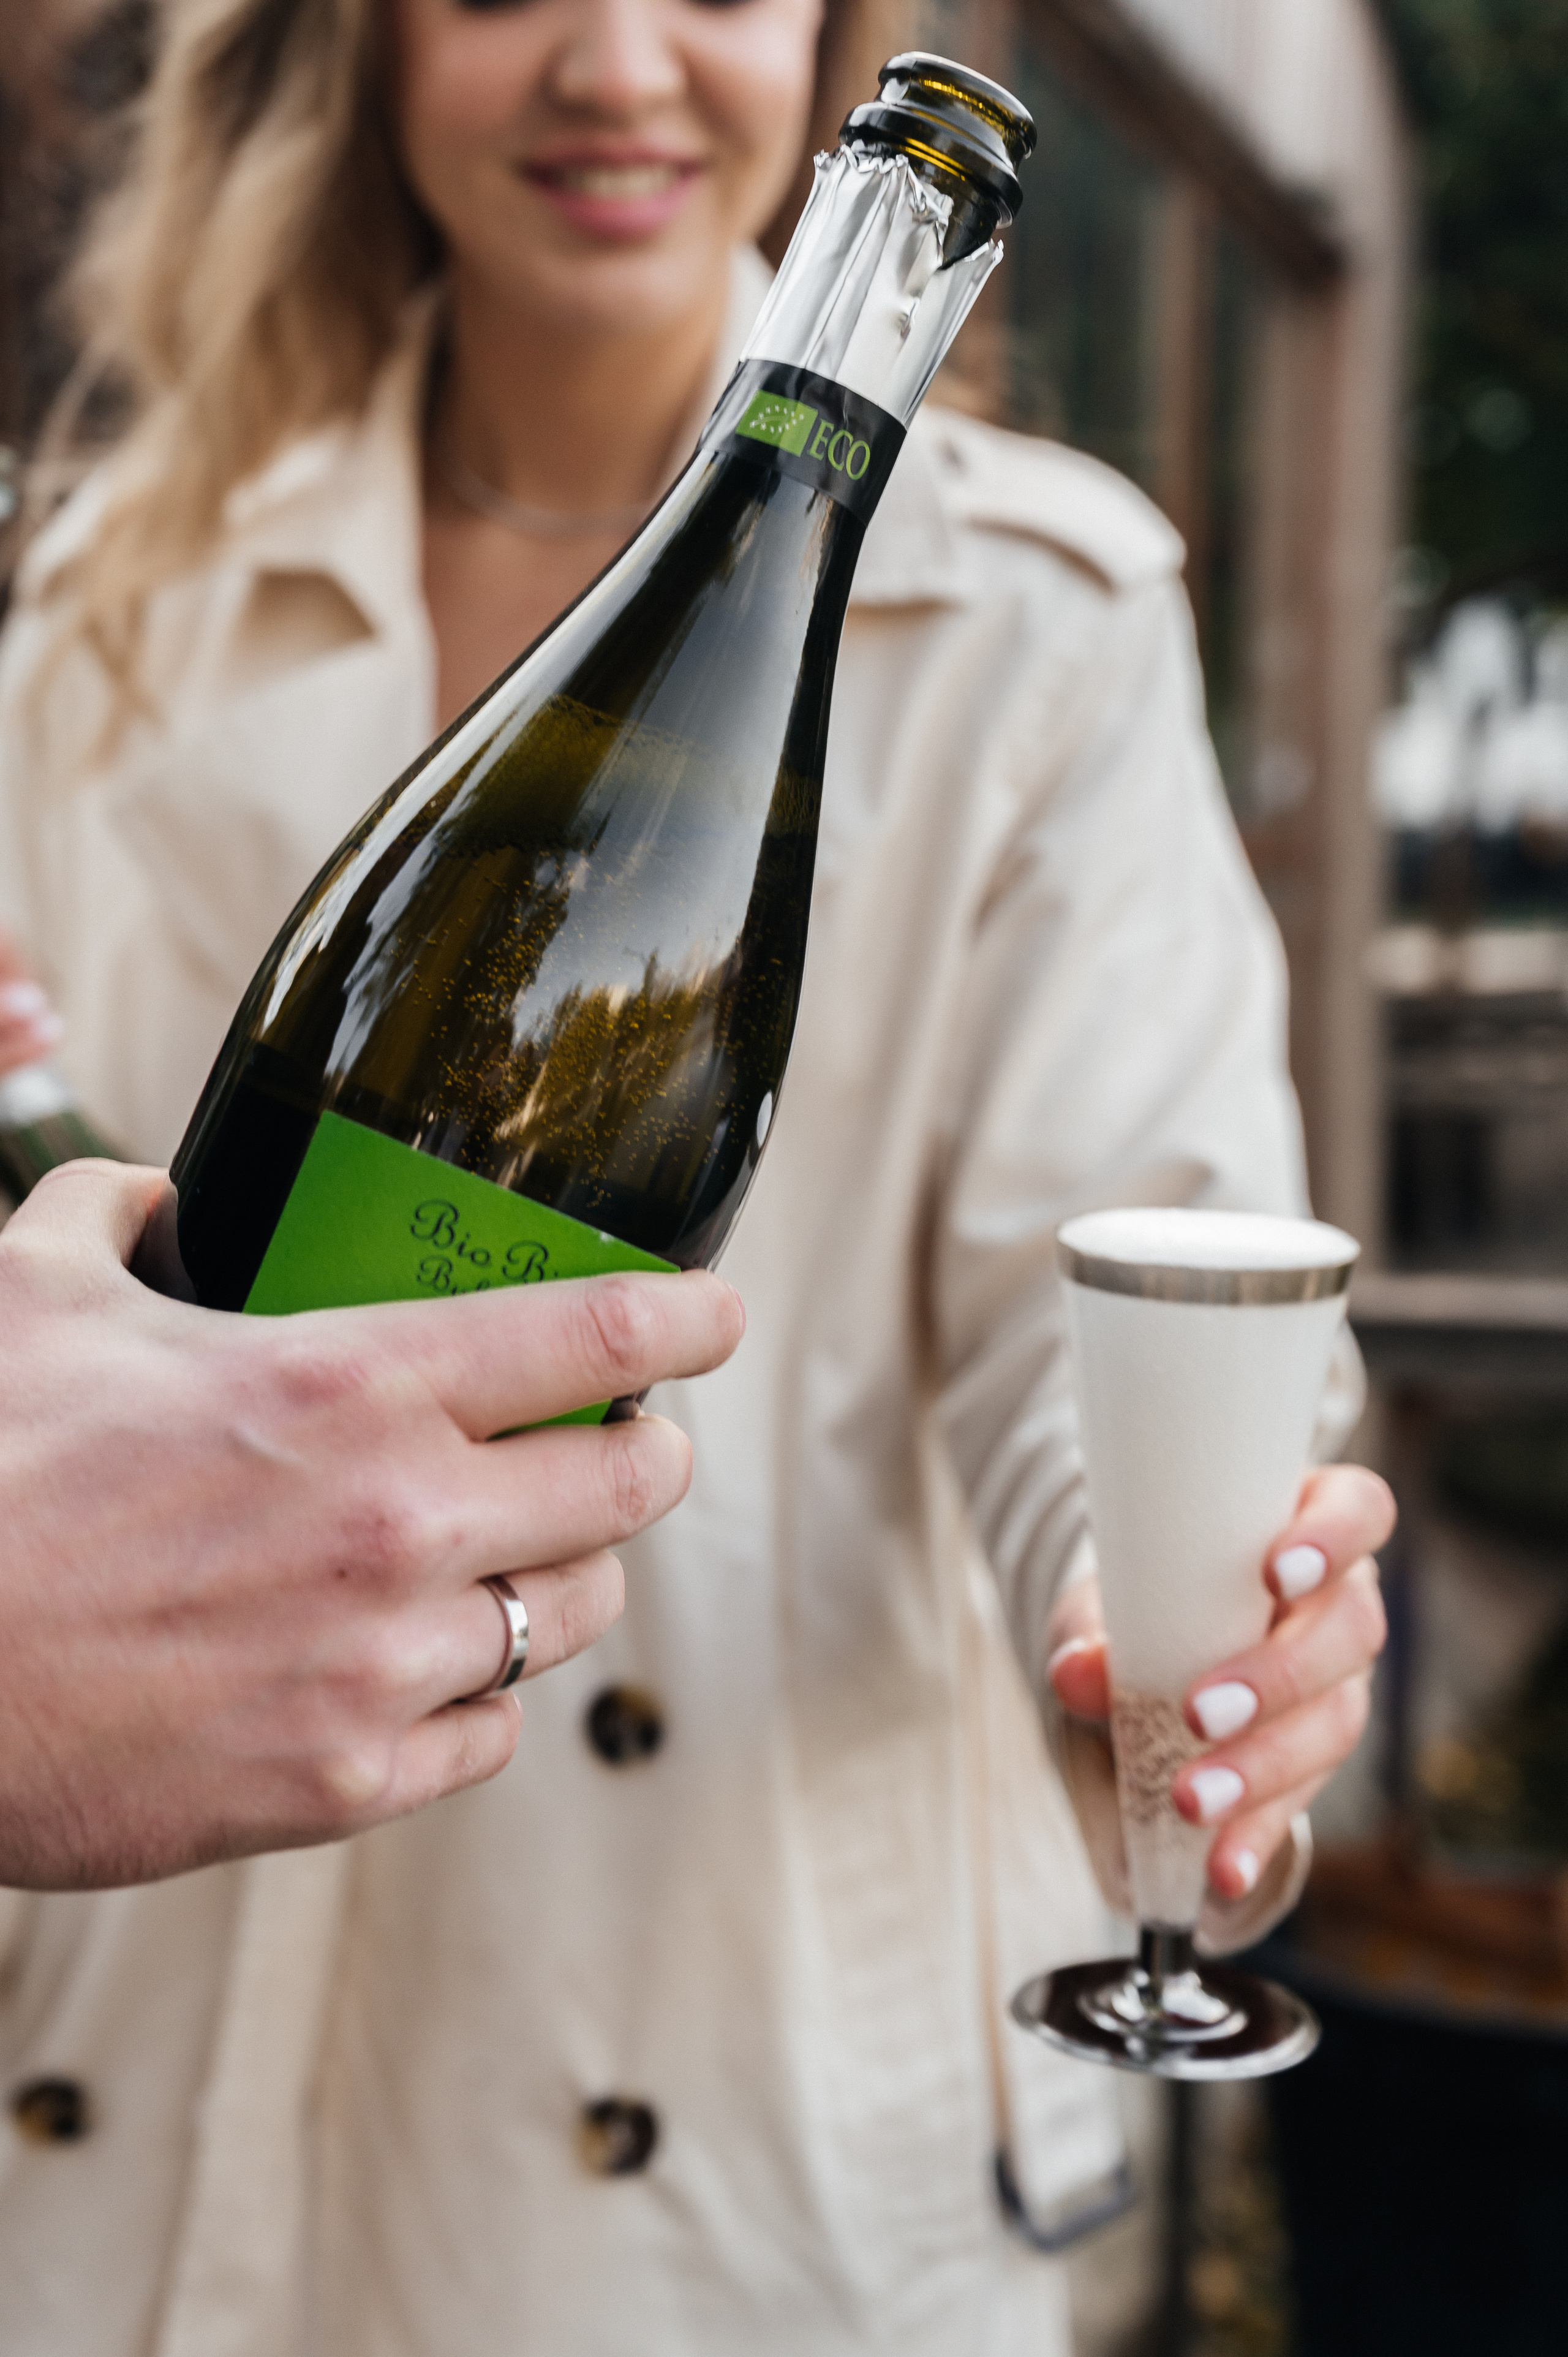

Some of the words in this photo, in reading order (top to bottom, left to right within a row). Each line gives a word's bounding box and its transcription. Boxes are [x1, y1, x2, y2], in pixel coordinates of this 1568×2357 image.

[808, 420, 870, 480] ECO
[410, 1199, 490, 1267] Bio
[502, 1240, 559, 1284] B
